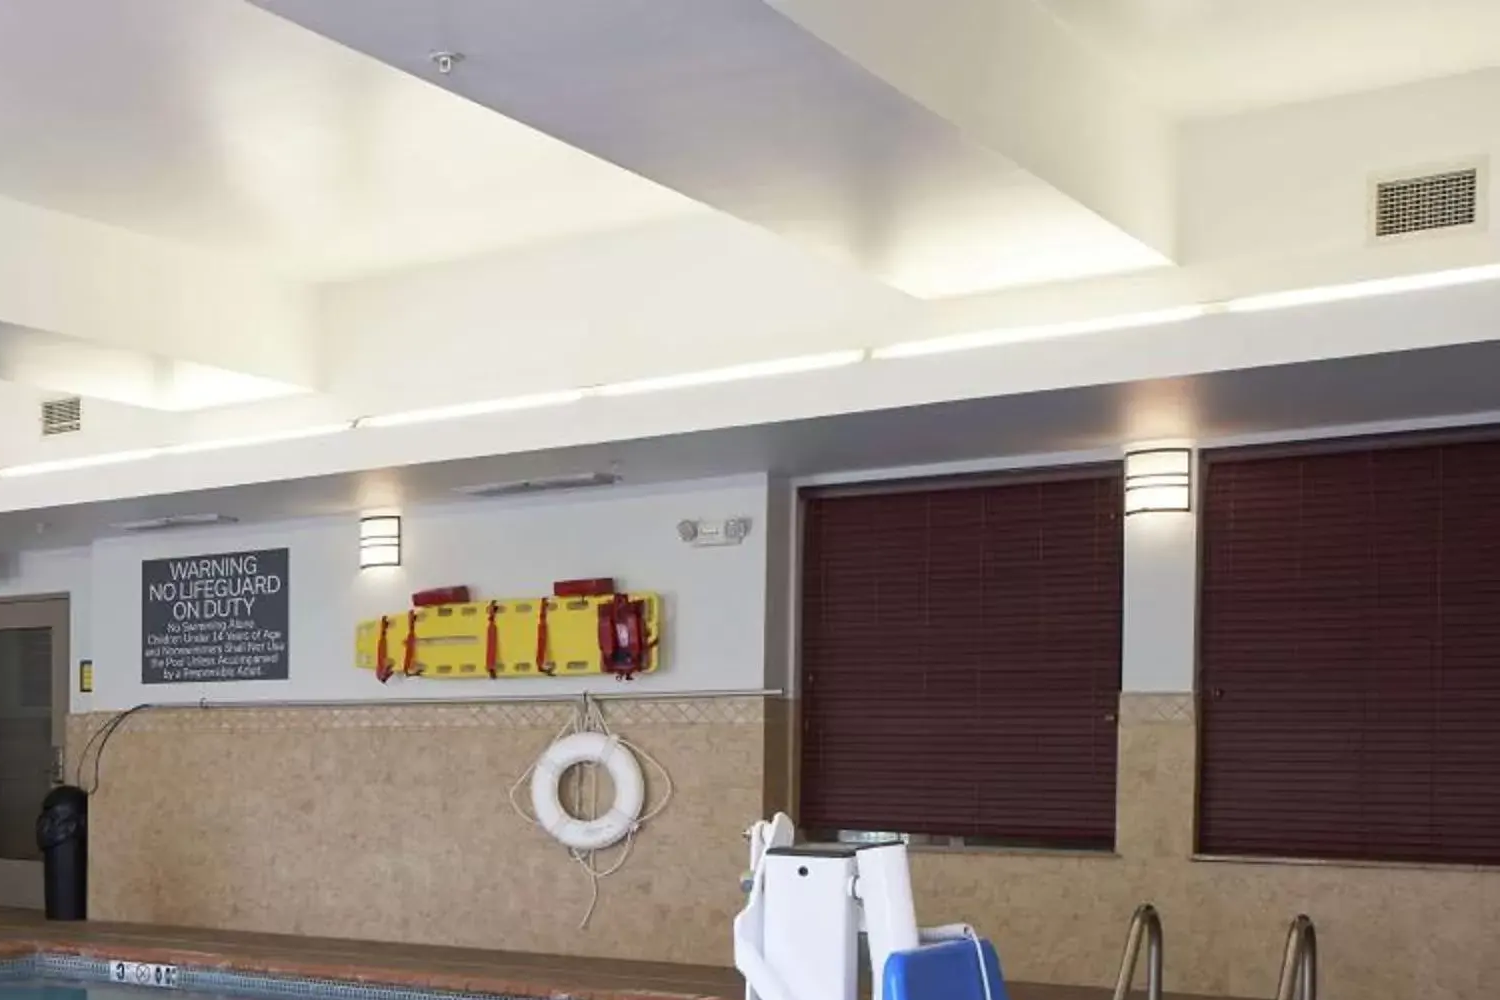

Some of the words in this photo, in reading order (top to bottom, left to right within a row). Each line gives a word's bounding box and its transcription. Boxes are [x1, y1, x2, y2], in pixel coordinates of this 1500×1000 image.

[169, 555, 257, 580] WARNING
[149, 582, 177, 601] NO
[180, 575, 281, 600] LIFEGUARD
[173, 601, 200, 621] ON
[203, 597, 256, 618] DUTY
